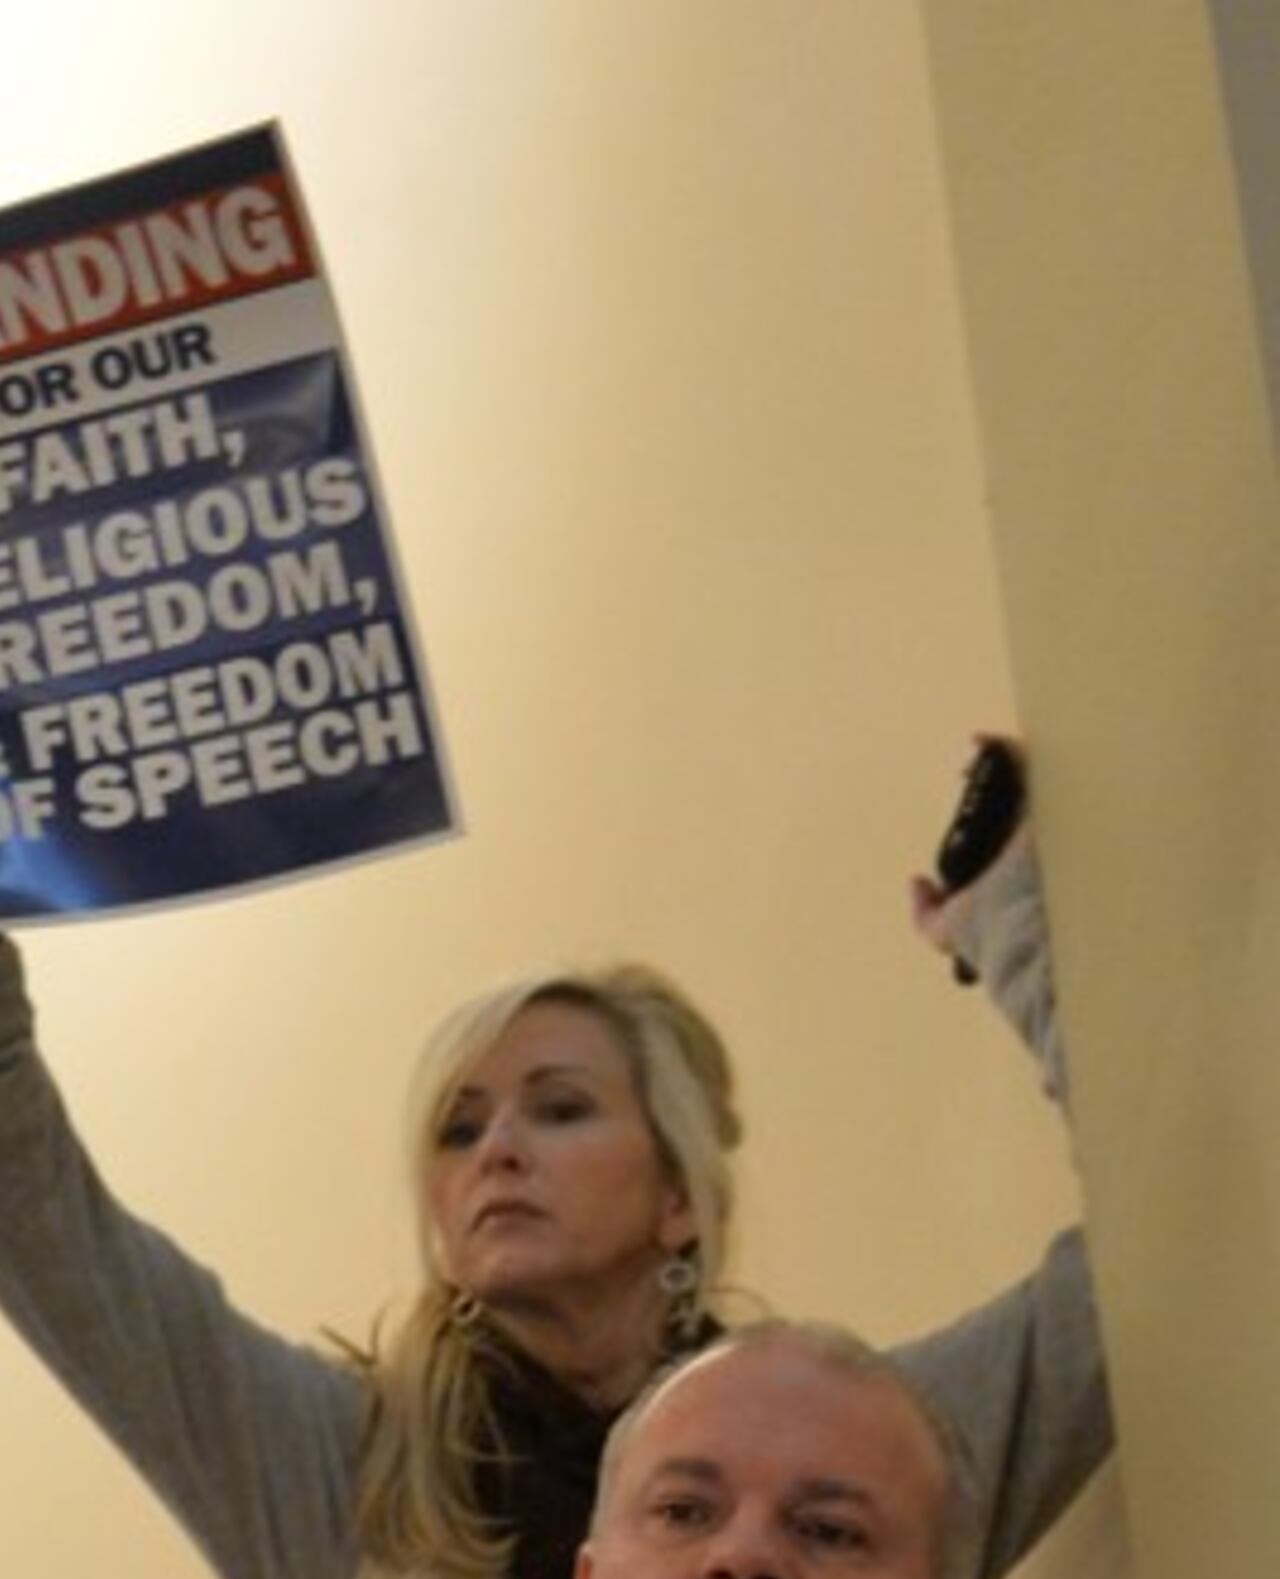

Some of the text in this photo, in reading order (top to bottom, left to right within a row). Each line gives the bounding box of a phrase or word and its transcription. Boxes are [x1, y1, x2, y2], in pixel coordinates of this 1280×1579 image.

[93, 325, 216, 391] OUR
[22, 624, 405, 773] FREEDOM
[78, 693, 424, 830] SPEECH
